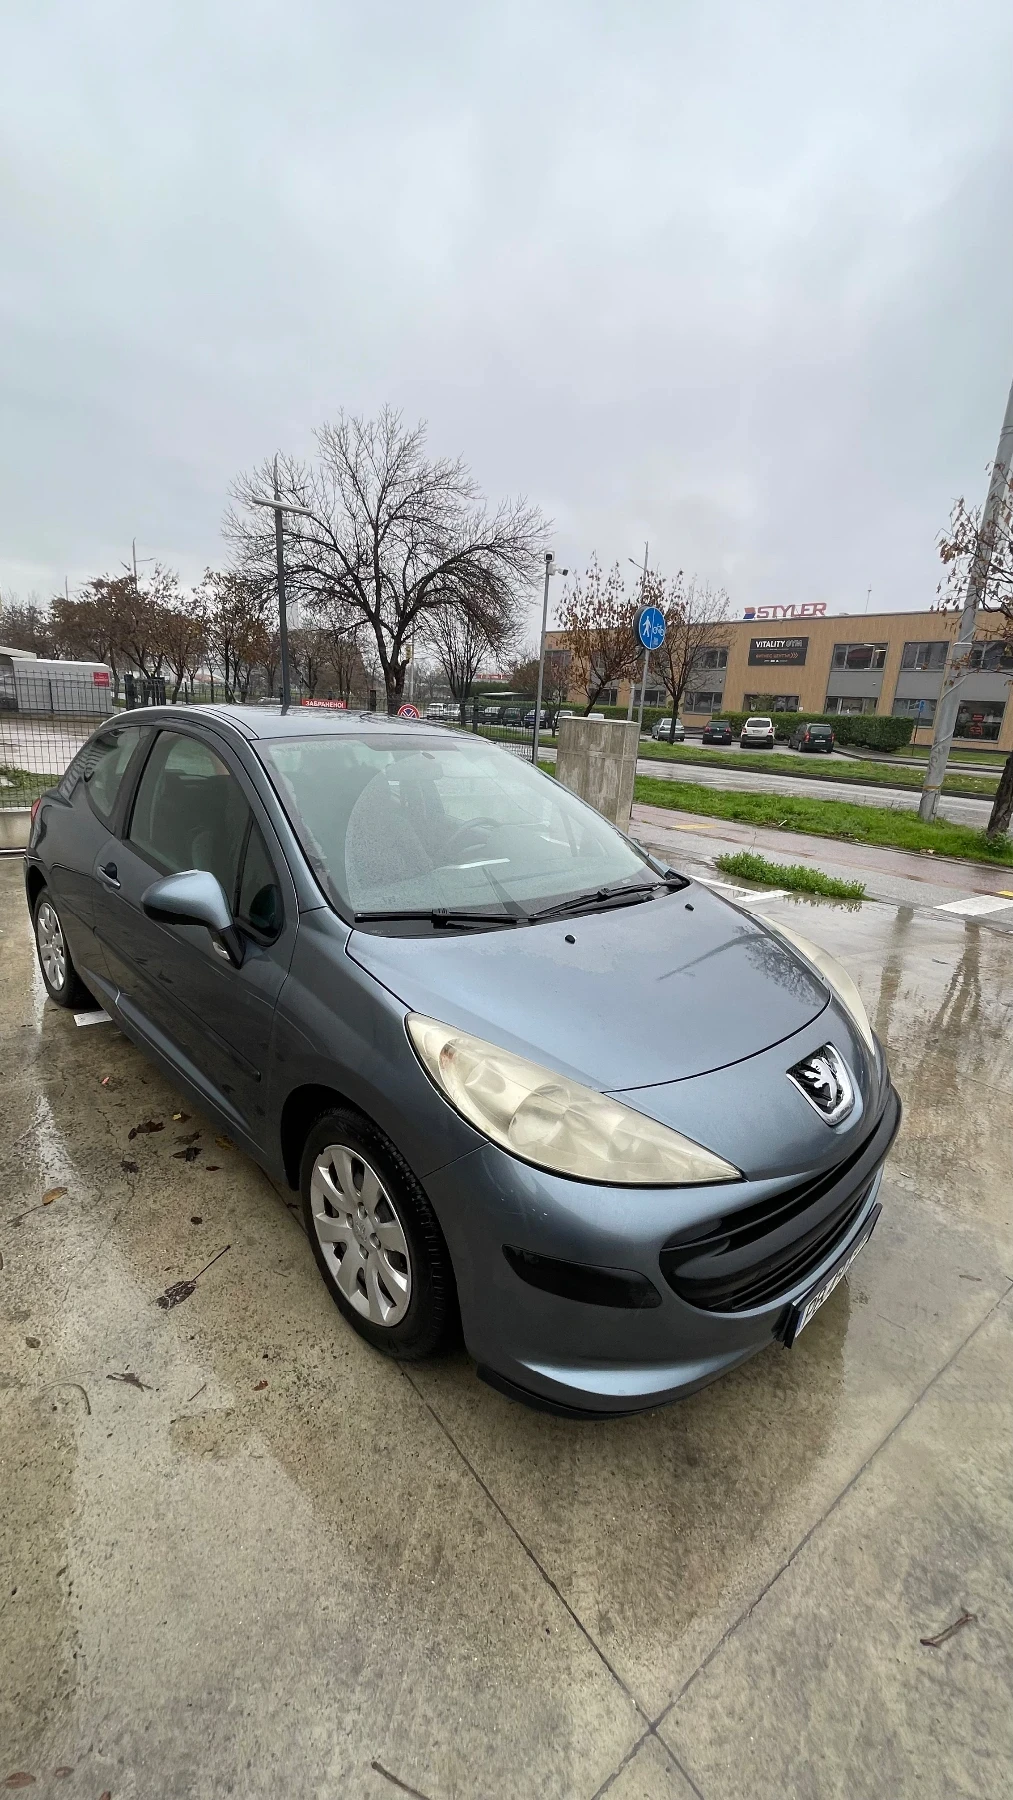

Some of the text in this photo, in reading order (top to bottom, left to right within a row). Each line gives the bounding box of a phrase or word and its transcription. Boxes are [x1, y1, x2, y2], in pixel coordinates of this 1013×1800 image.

[757, 602, 827, 618] STYLER
[755, 640, 786, 648] VITALITY
[305, 700, 344, 708] ЗАБРАНЕНО!
